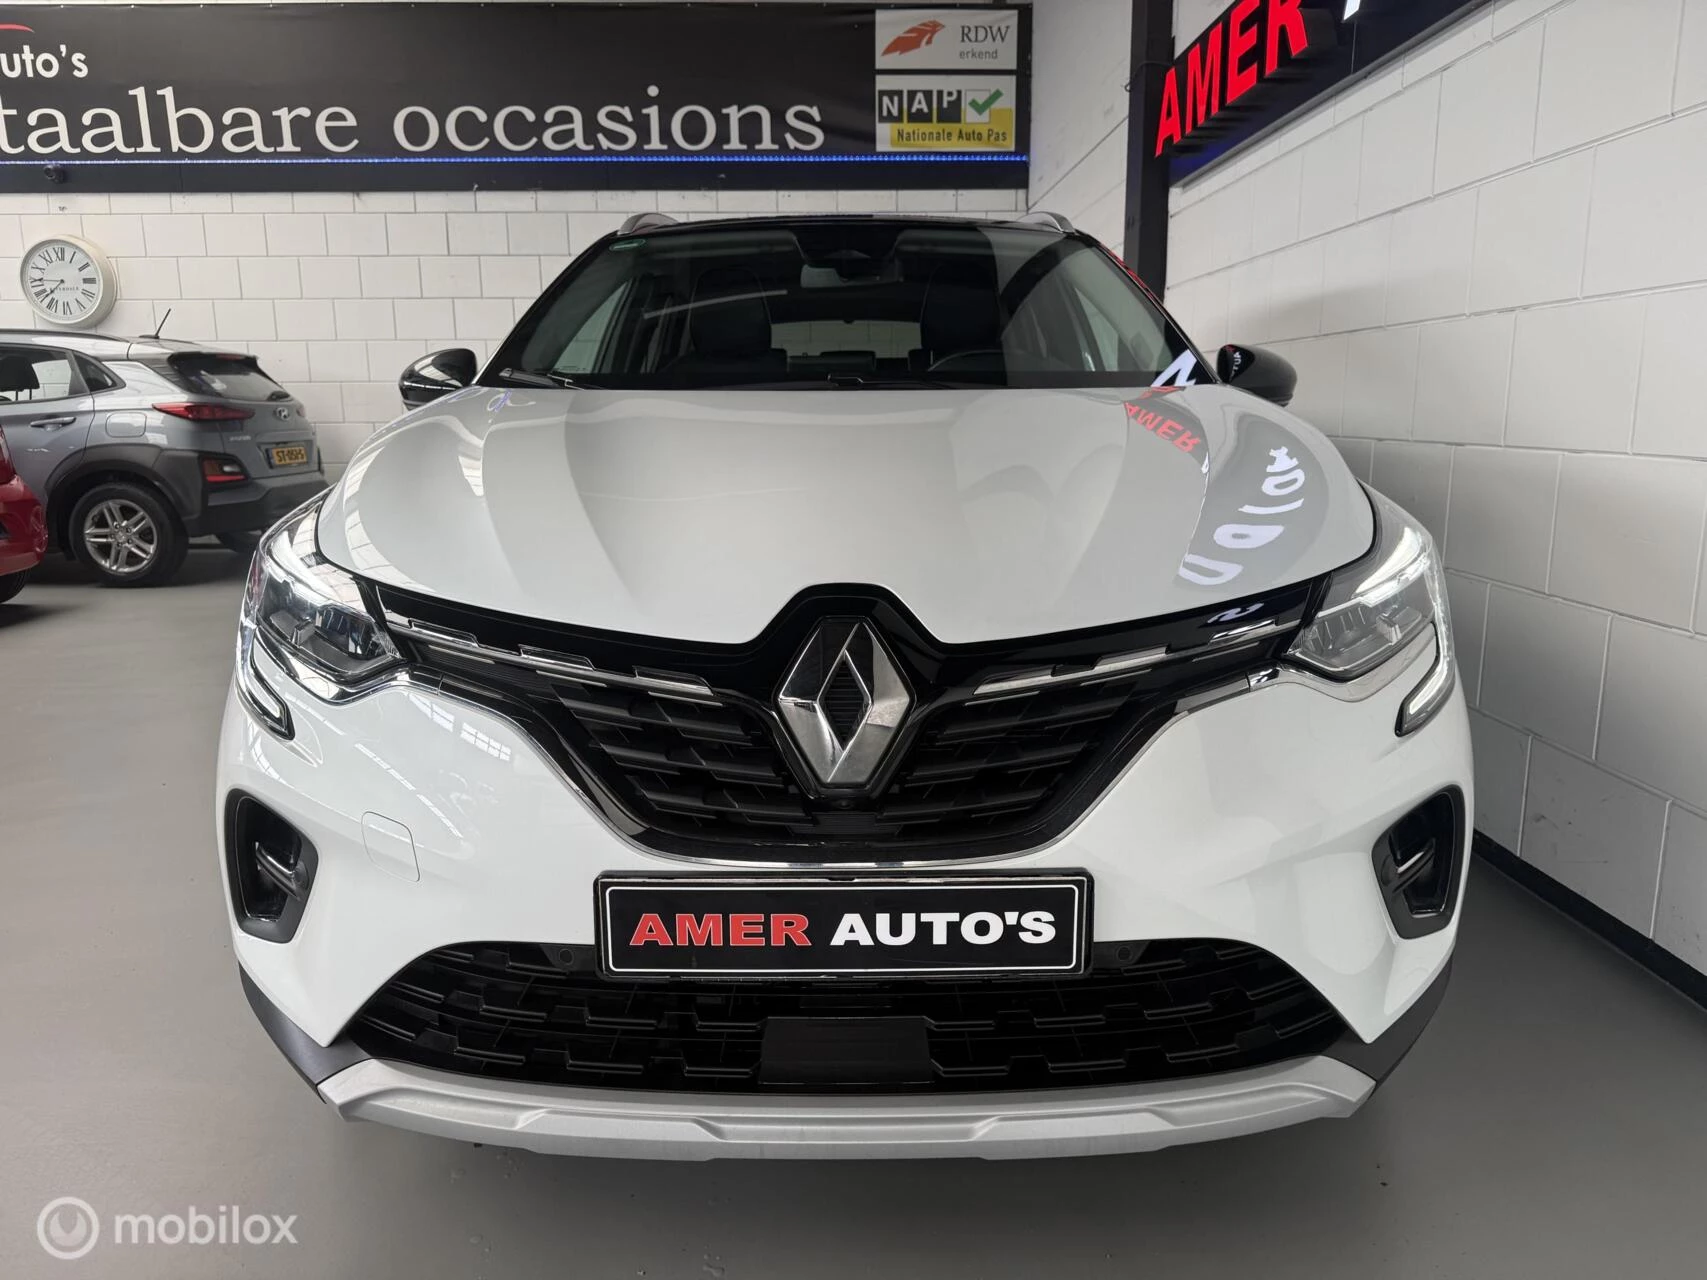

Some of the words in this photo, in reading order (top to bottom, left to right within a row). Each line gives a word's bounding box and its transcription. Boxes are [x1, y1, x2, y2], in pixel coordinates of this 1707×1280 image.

[960, 25, 1011, 43] RDW
[0, 44, 88, 78] uto's
[959, 48, 998, 60] erkend
[1155, 0, 1308, 158] AMER
[0, 86, 359, 154] taalbare
[393, 85, 825, 152] occasions
[897, 127, 953, 142] Nationale
[958, 128, 983, 142] Auto
[987, 128, 1008, 142] Pas
[629, 913, 812, 946] AMER
[830, 911, 1056, 945] AUTO'S
